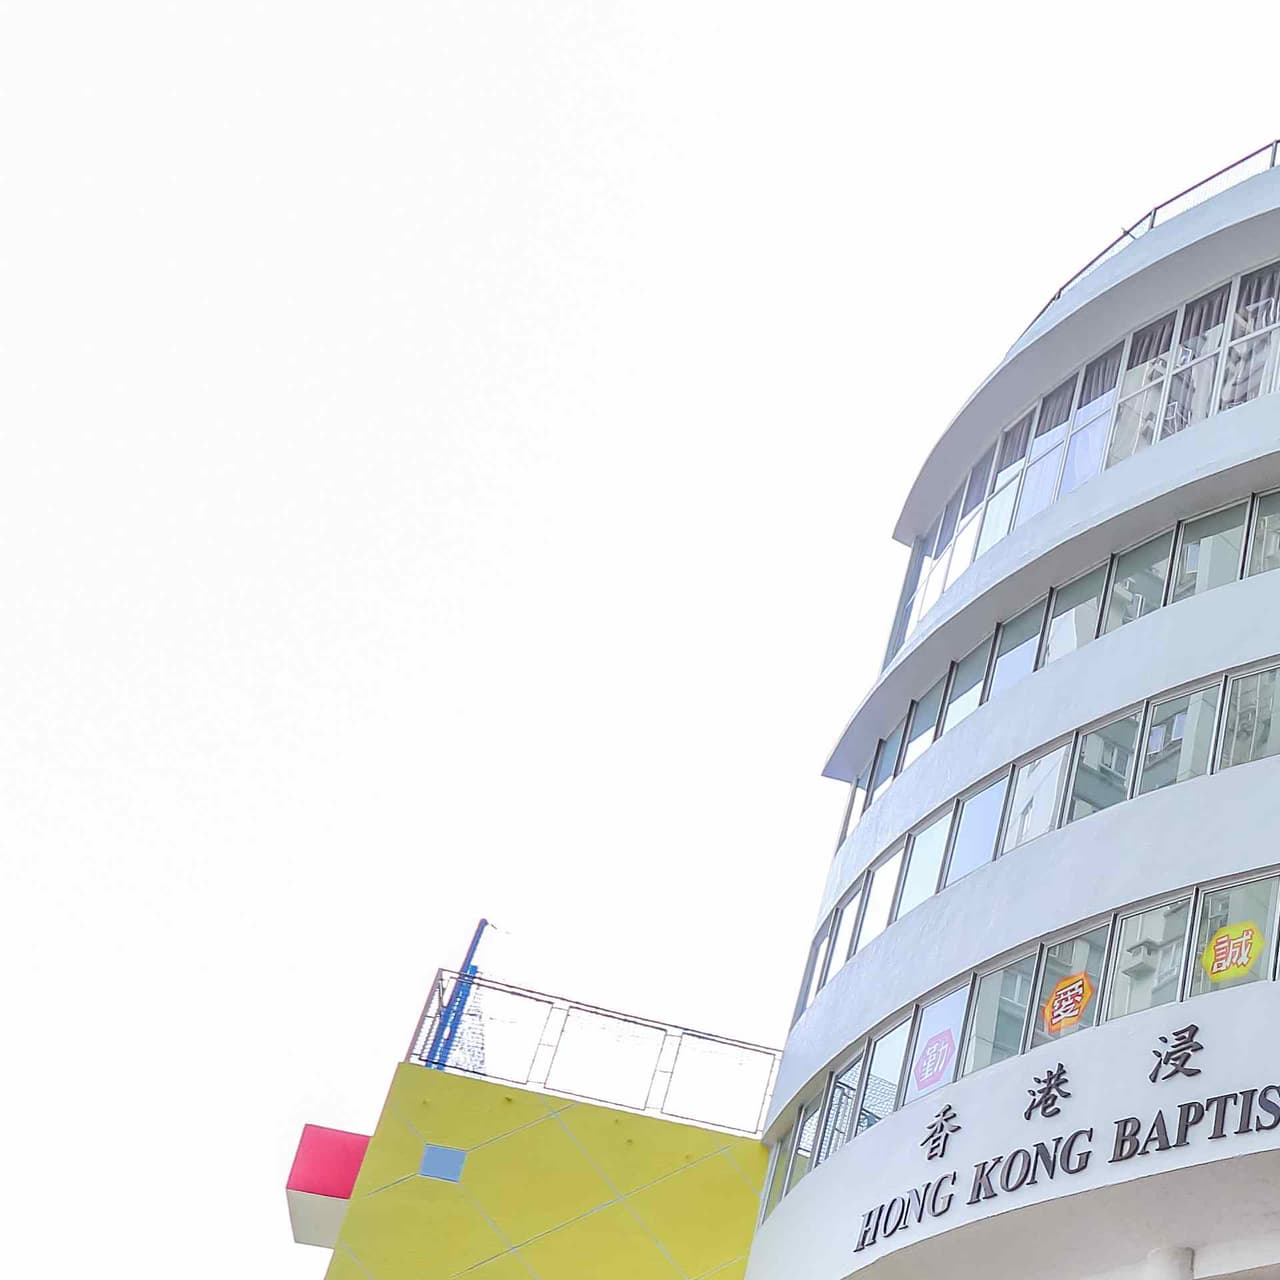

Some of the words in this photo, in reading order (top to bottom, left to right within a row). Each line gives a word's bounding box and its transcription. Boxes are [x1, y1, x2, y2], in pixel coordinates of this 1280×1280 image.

[1209, 929, 1254, 976] 誠
[1051, 978, 1086, 1025] 愛
[918, 1035, 956, 1083] 勤
[853, 1171, 957, 1254] HONG
[966, 1128, 1093, 1206] KONG
